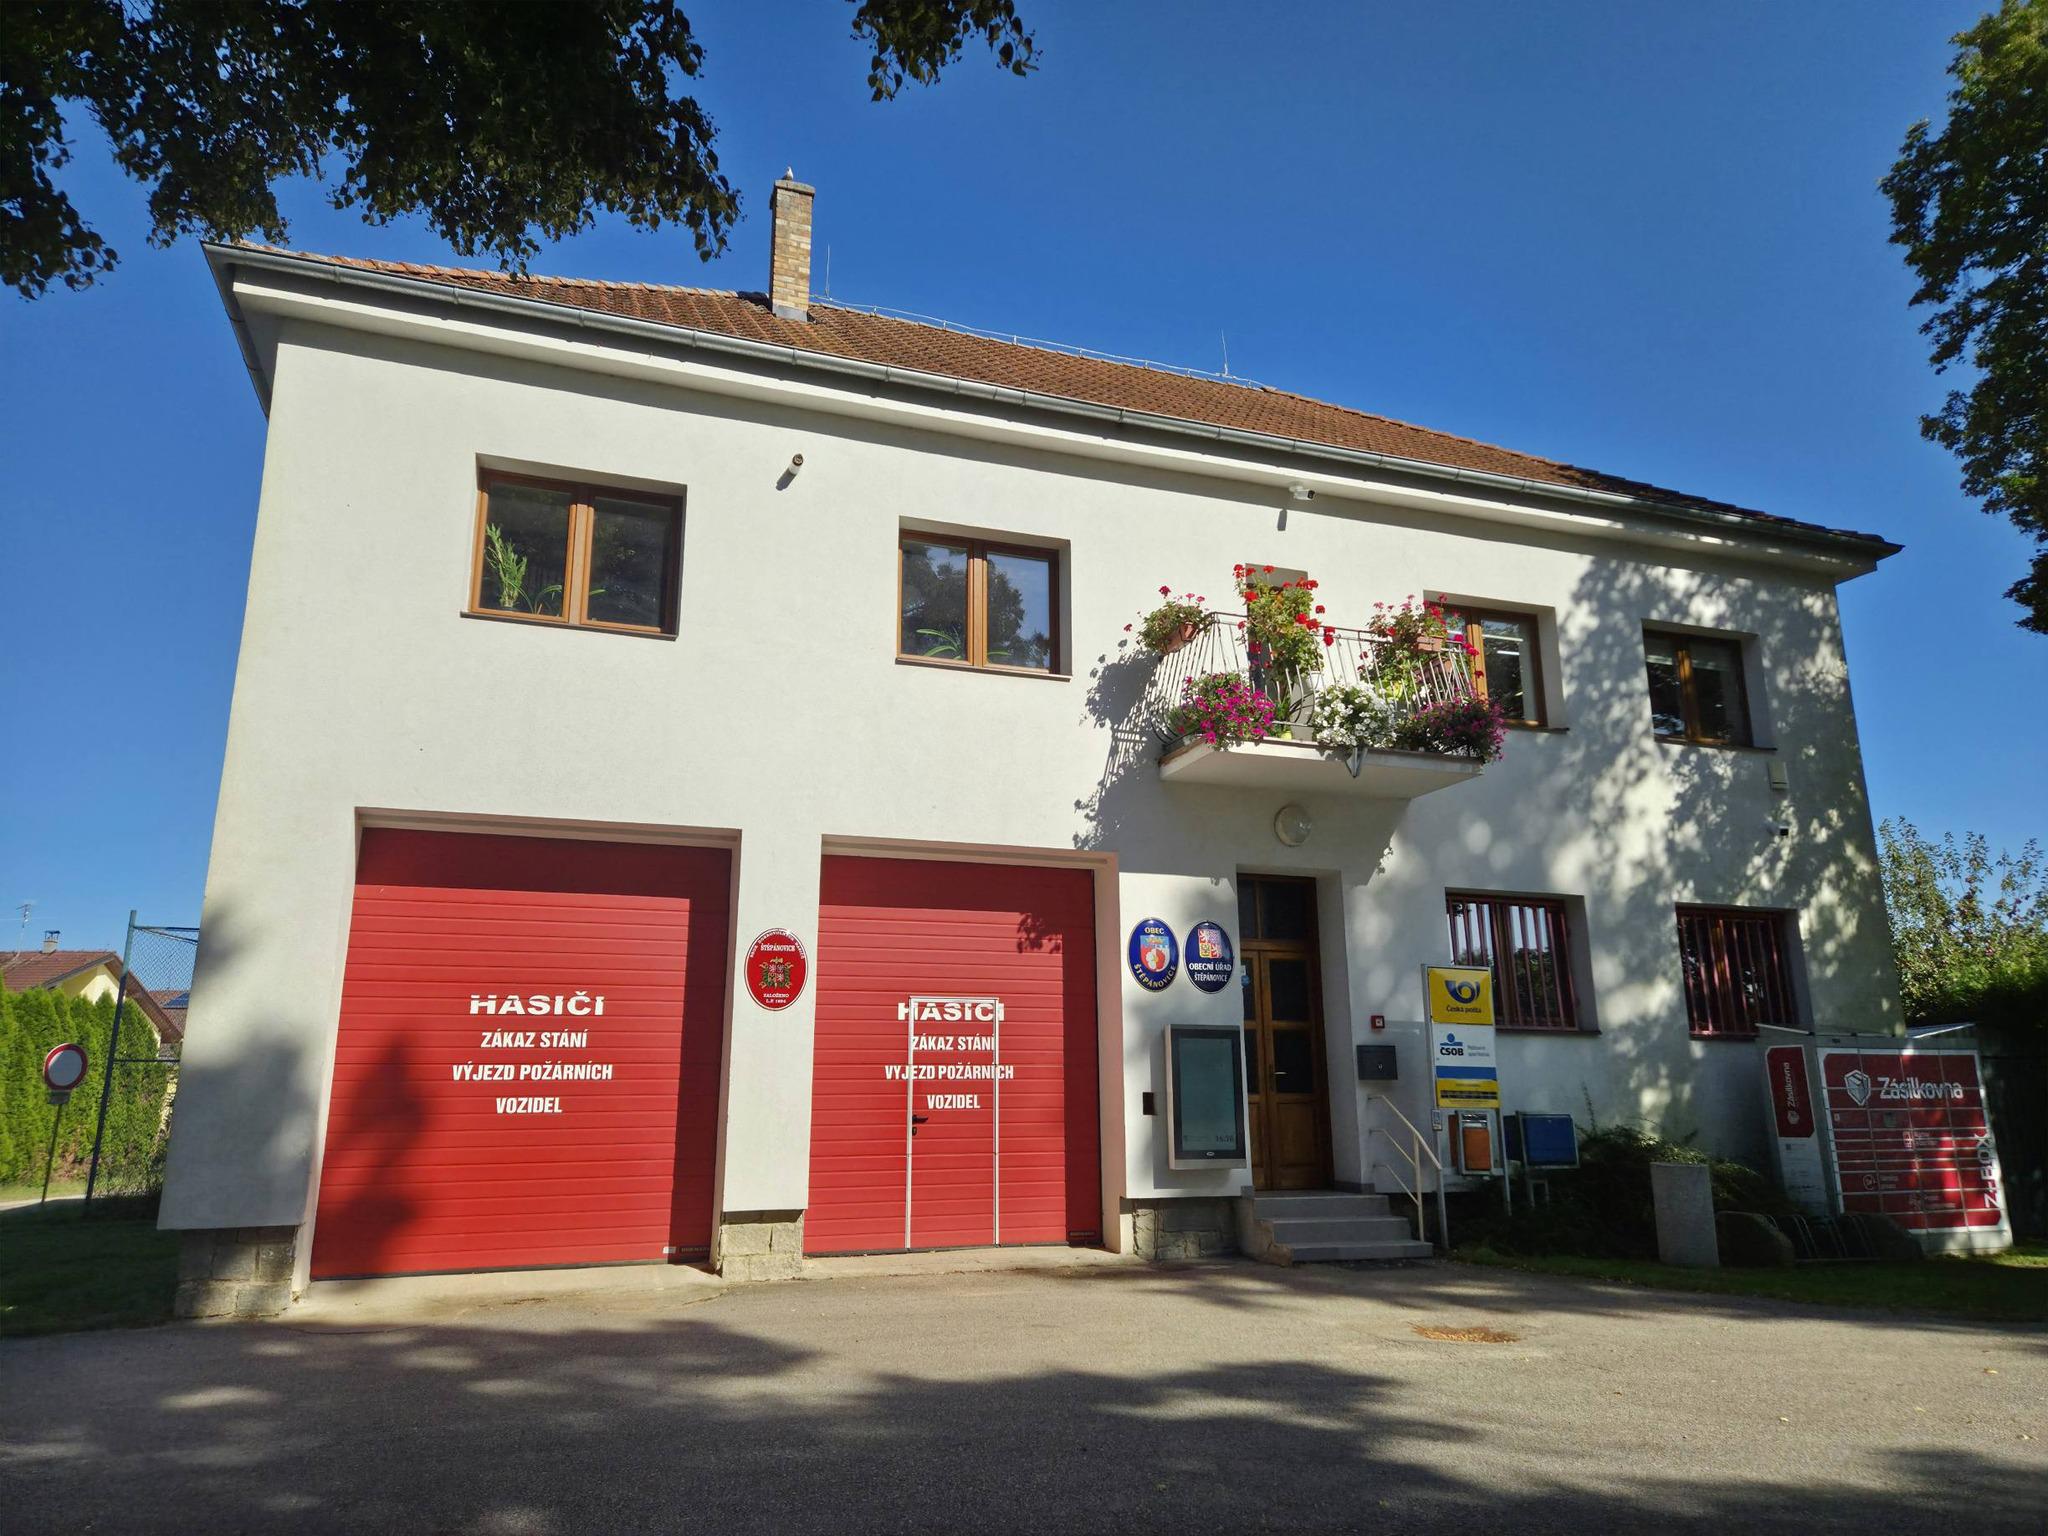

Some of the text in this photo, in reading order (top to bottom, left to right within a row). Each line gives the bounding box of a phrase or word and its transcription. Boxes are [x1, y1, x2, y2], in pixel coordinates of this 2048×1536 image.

[1144, 927, 1165, 935] OBEC
[1189, 962, 1232, 971] OBECNÍ ÚŘAD
[1194, 972, 1228, 982] ŠTĚPÁNOVICE
[469, 990, 605, 1016] HASIČI
[480, 1028, 589, 1048] ZÁKAZ STÁNÍ
[911, 1033, 954, 1051] ZÁKAZ
[1440, 1047, 1464, 1056] ČSOB
[452, 1060, 613, 1081] VÝJEZD POŽÁRNÍCH
[938, 1062, 1014, 1080] POŽÁRNÍCH
[1877, 1077, 1964, 1099] Zásilkovna
[495, 1097, 563, 1114] VOZIDEL
[927, 1094, 981, 1110] VOZIDEL
[1974, 1128, 2002, 1209] Z-BOX
